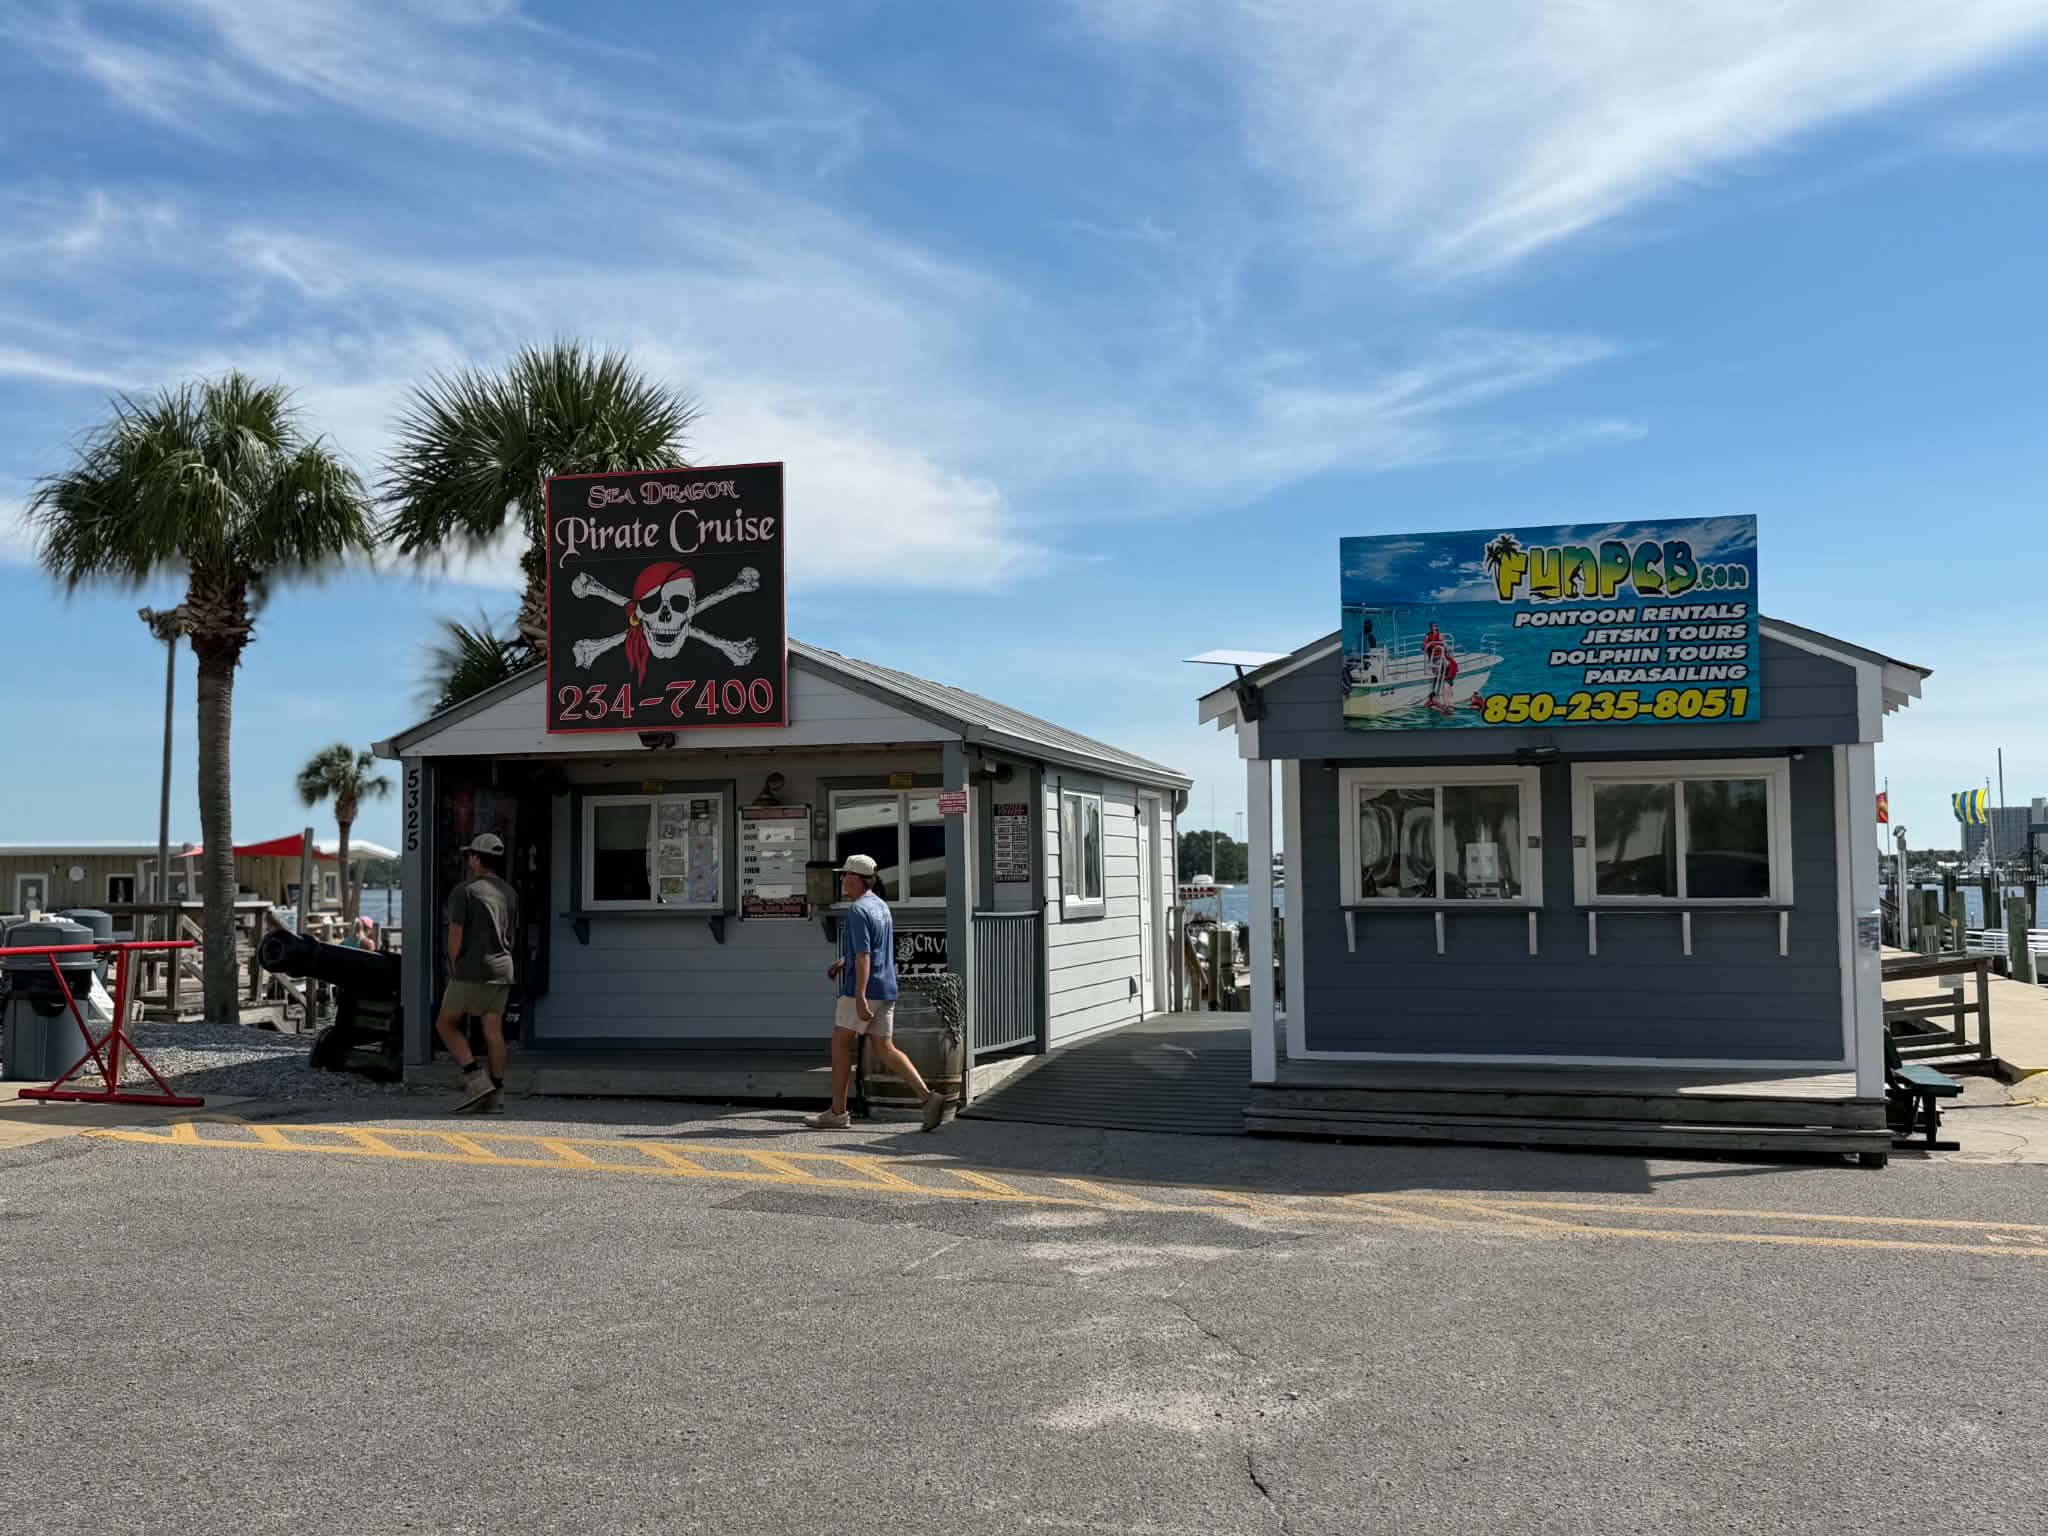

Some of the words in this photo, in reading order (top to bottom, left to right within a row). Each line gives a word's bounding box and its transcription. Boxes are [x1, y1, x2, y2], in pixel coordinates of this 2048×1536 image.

[555, 516, 660, 569] Pirate
[669, 508, 776, 553] Cruise
[1515, 608, 1635, 627] PONTOON
[1642, 603, 1747, 622] RENTALS
[1582, 627, 1659, 645] JETSKI
[1667, 624, 1747, 641] TOURS
[1550, 647, 1659, 666] DOLPHIN
[1667, 645, 1747, 662] TOURS
[1584, 665, 1748, 685] PARASAILING
[558, 678, 774, 721] 234-7400
[1484, 688, 1749, 723] 850-235-8051
[407, 768, 419, 851] 5325
